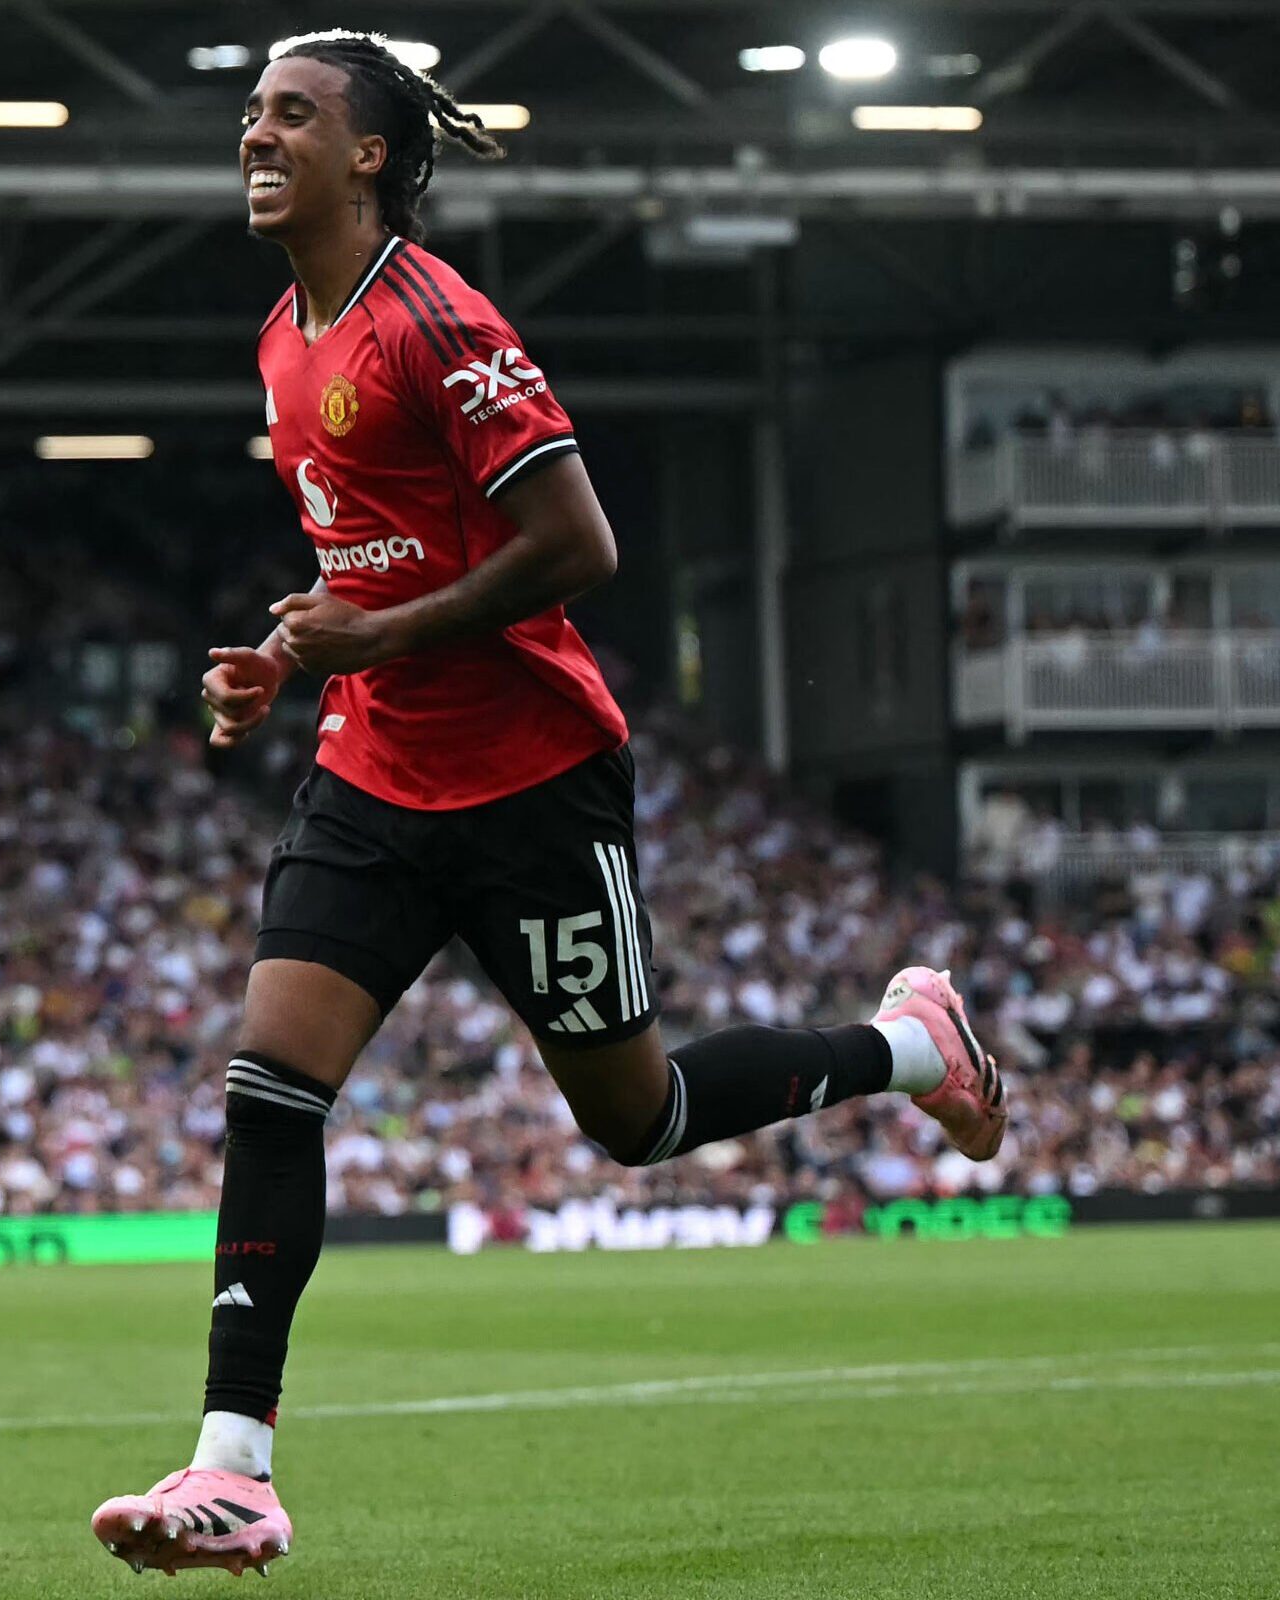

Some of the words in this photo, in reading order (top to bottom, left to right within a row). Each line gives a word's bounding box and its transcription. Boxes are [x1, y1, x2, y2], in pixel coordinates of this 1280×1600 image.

[442, 347, 544, 414] DXC
[469, 380, 547, 425] TECHNOLOG
[519, 910, 608, 995] 15
